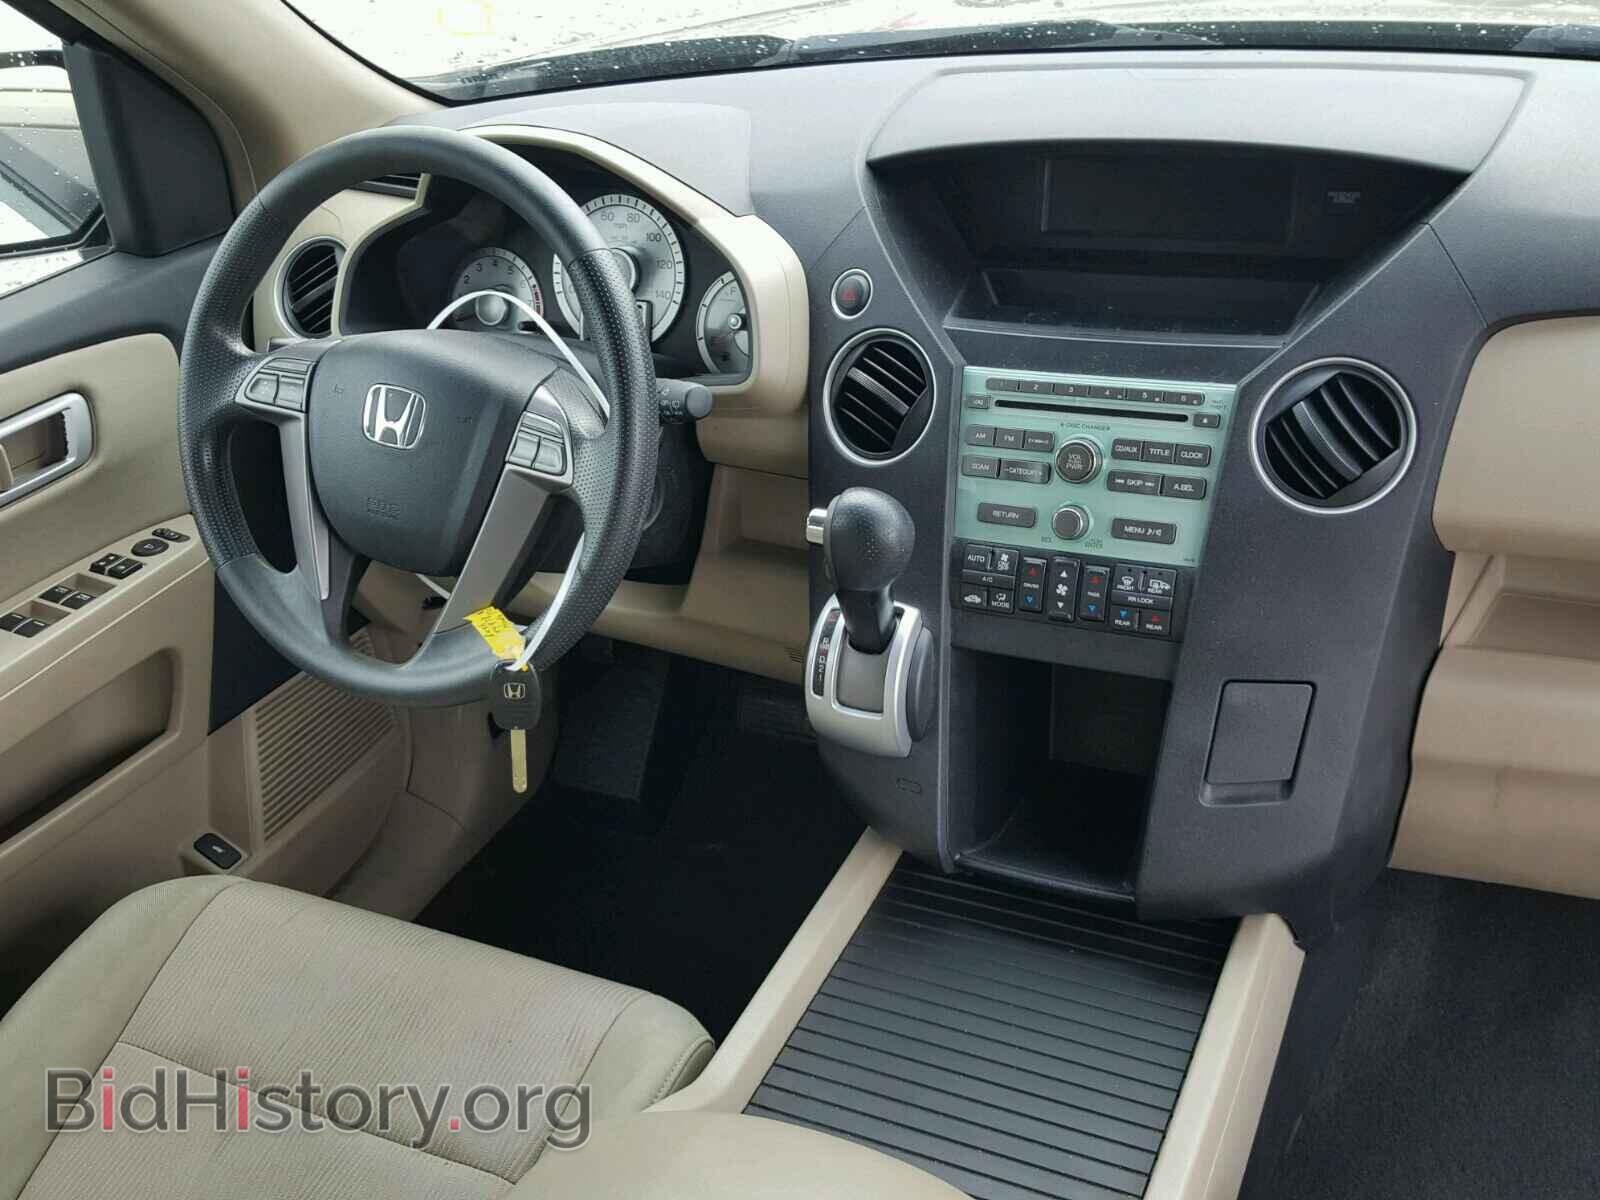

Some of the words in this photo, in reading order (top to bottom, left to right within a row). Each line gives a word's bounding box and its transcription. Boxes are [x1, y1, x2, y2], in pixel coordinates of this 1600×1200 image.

[626, 212, 641, 223] 80
[645, 232, 662, 242] 100
[655, 259, 673, 270] 120
[463, 274, 471, 284] 2
[655, 289, 672, 300] 140
[975, 431, 987, 440] AM
[1148, 447, 1170, 457] TITLE
[1180, 450, 1204, 459] CLOCK
[971, 462, 991, 471] SCAN
[1126, 478, 1144, 487] SKIP
[991, 510, 1020, 520] RETURN
[1123, 525, 1145, 535] MENU
[967, 554, 986, 563] AUTO
[991, 600, 1010, 609] MODE
[1137, 597, 1155, 605] LOCK
[1145, 623, 1163, 631] REAR
